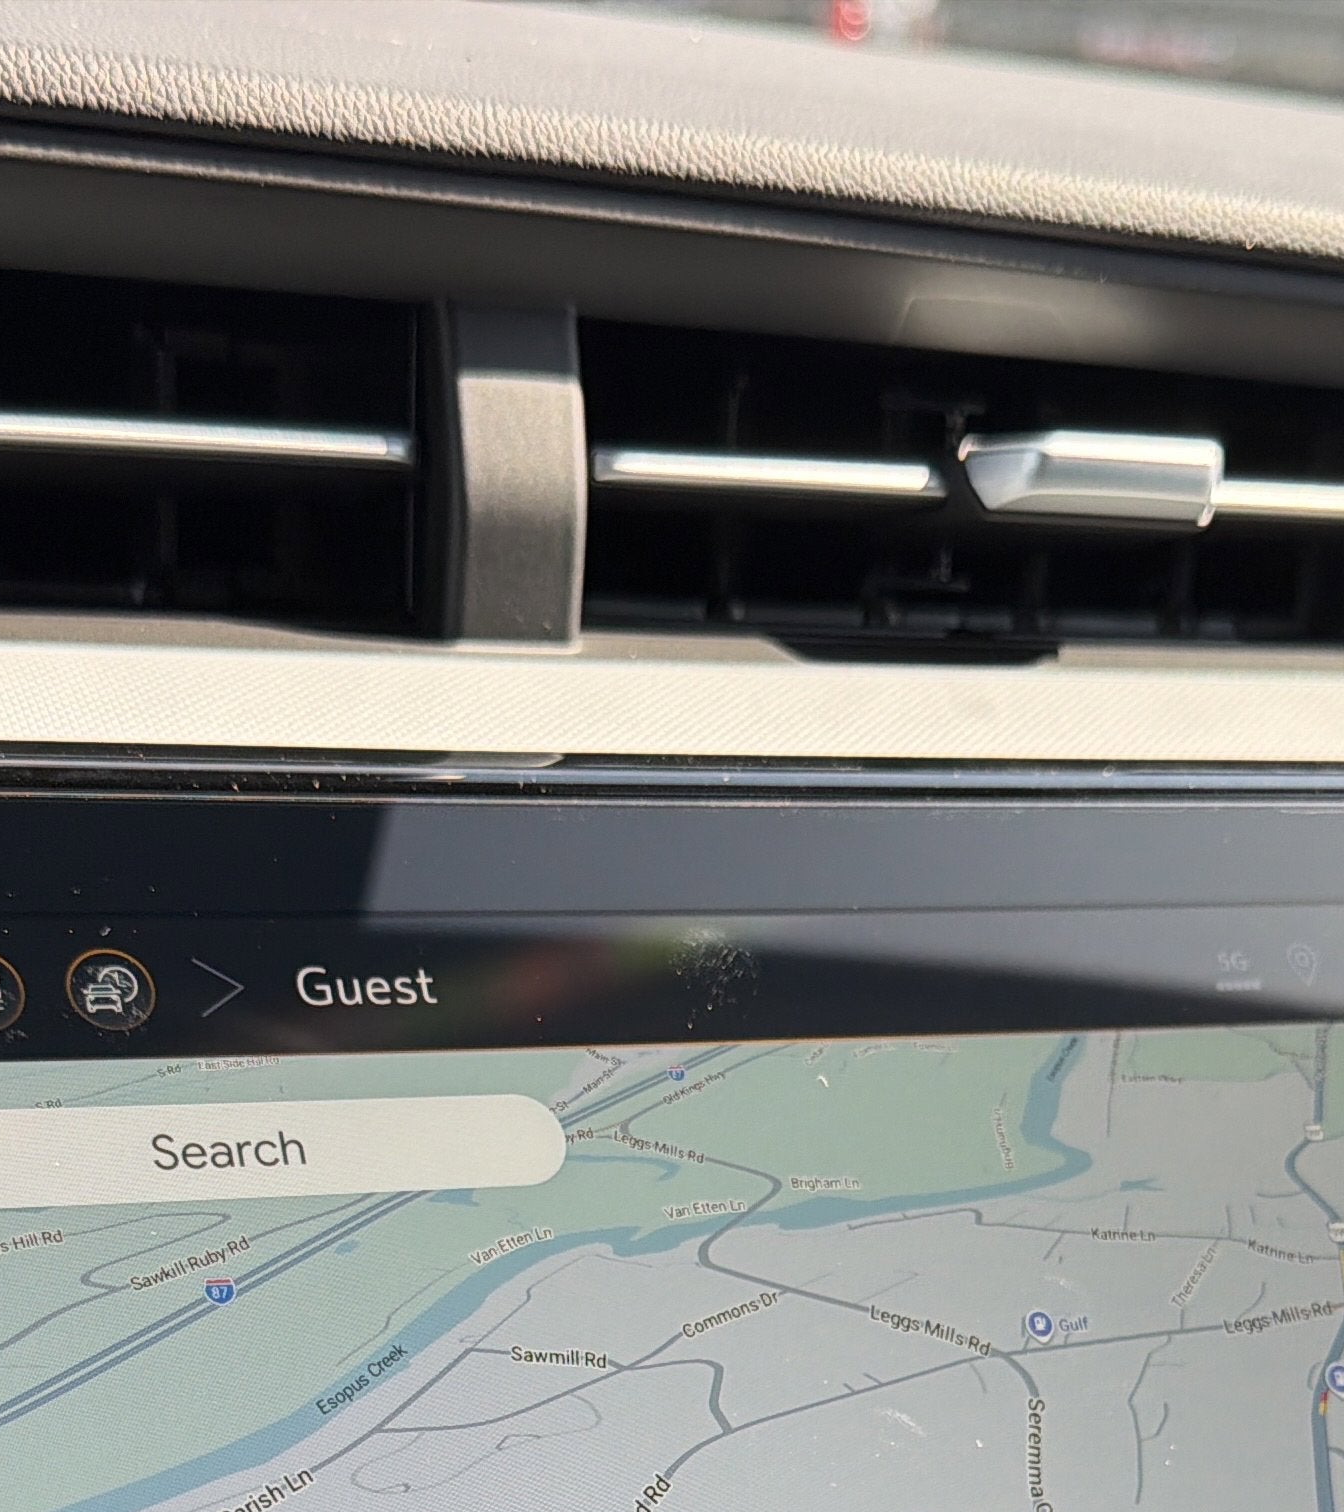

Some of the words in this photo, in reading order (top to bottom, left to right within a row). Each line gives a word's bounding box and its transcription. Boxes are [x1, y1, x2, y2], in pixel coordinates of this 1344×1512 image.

[1218, 951, 1250, 972] 5G
[296, 966, 439, 1007] Guest
[167, 1063, 182, 1076] Rd
[678, 1080, 705, 1100] Kings
[47, 1098, 63, 1109] Rd
[577, 1128, 594, 1140] Rd
[151, 1131, 308, 1171] Search
[613, 1131, 656, 1151] Leggs
[656, 1141, 685, 1158] Mills
[687, 1149, 705, 1164] Rd
[791, 1177, 842, 1191] Brigham
[663, 1204, 689, 1221] Van
[691, 1201, 726, 1218] Etten
[729, 1199, 746, 1214] Ln
[12, 1232, 40, 1251] Hill
[41, 1229, 64, 1246] Rd
[469, 1245, 498, 1267] Van
[498, 1231, 536, 1257] Etten
[537, 1227, 554, 1243] Ln
[1140, 1230, 1156, 1242] Ln
[129, 1257, 187, 1293] Sawkill
[188, 1245, 229, 1274] Ruby
[230, 1235, 251, 1256] Rd
[1299, 1250, 1314, 1264] Ln
[1170, 1261, 1207, 1308] Theresa
[1203, 1247, 1216, 1265] Ln
[211, 1284, 229, 1299] 87
[681, 1297, 757, 1340] Commons
[758, 1288, 781, 1309] Dr
[1059, 1315, 1089, 1332] Gulf
[1223, 1317, 1271, 1335] Leggs
[1271, 1306, 1310, 1324] Mills
[1313, 1300, 1333, 1316] Rd
[869, 1304, 923, 1335] Leggs
[924, 1317, 963, 1345] Mills
[966, 1332, 992, 1357] Rd
[510, 1345, 580, 1367] Sawmill
[584, 1349, 609, 1370] Rd
[315, 1370, 369, 1417] Esopus
[362, 1342, 409, 1388] Creek
[1026, 1398, 1045, 1502] Seremma
[282, 1465, 315, 1493] Ln
[642, 1473, 672, 1504] Rd
